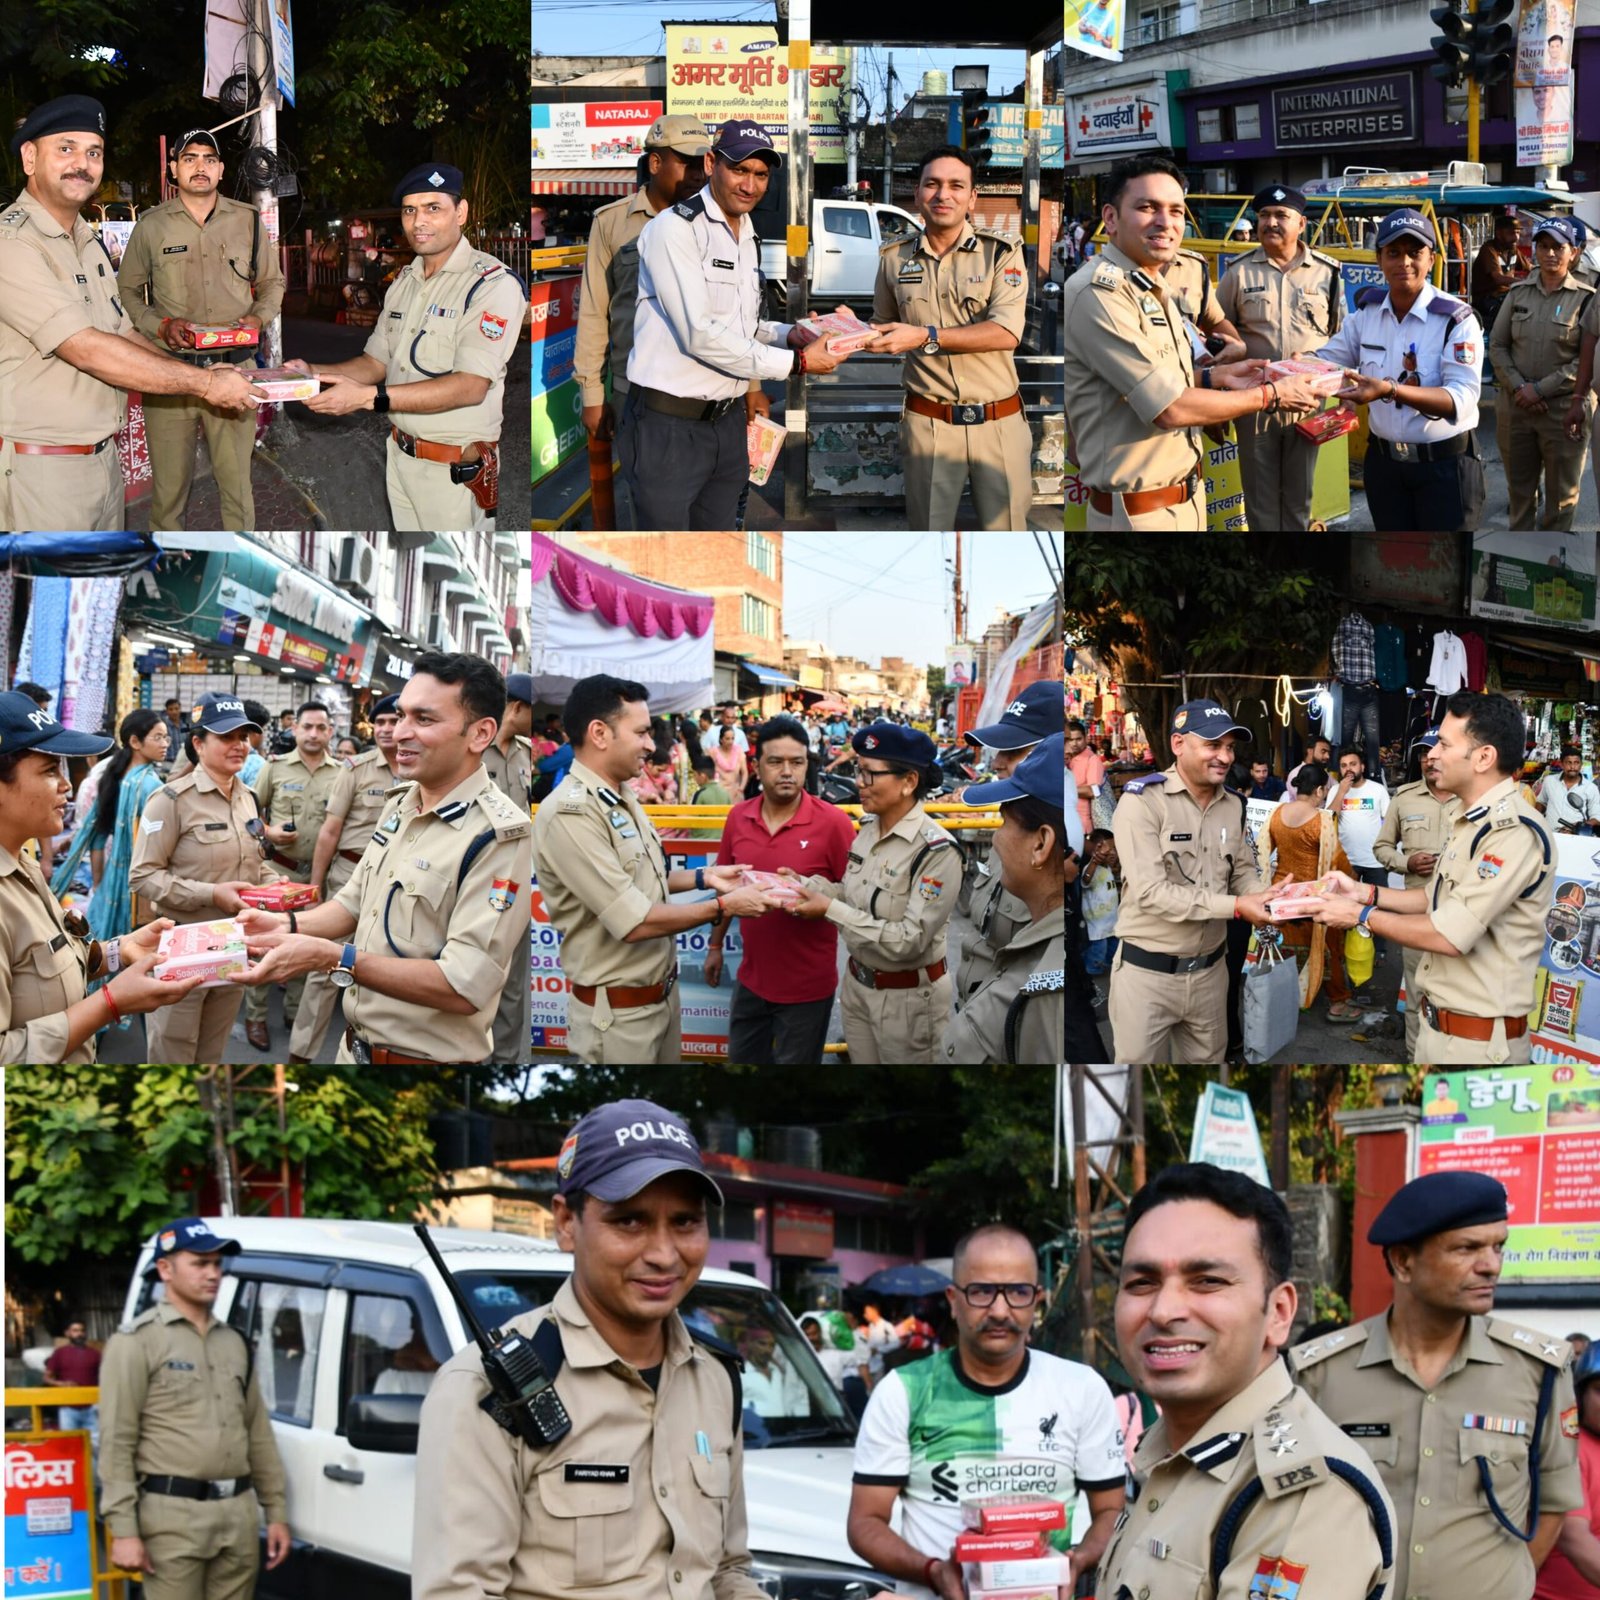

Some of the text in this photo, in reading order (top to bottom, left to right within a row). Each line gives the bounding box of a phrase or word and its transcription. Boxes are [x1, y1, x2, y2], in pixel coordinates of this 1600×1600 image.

[671, 63, 726, 86] अमर
[729, 56, 774, 95] मूर्ति
[1280, 84, 1399, 113] INTERNATIONAL
[1280, 114, 1404, 139] ENTERPRISES
[1390, 217, 1424, 229] POLICE
[1346, 268, 1389, 285] अध्य
[1209, 441, 1238, 466] प्रति
[531, 1001, 558, 1010] ence
[681, 1007, 729, 1017] manitie
[1548, 1005, 1571, 1018] SHREE
[533, 1014, 566, 1025] 27018
[1546, 1015, 1569, 1028] CEMENT
[1465, 1072, 1541, 1113] डेंगू
[615, 1121, 692, 1149] POLICE
[5, 1450, 76, 1489] लिस
[966, 1462, 1056, 1479] standard
[966, 1479, 1057, 1494] chartered
